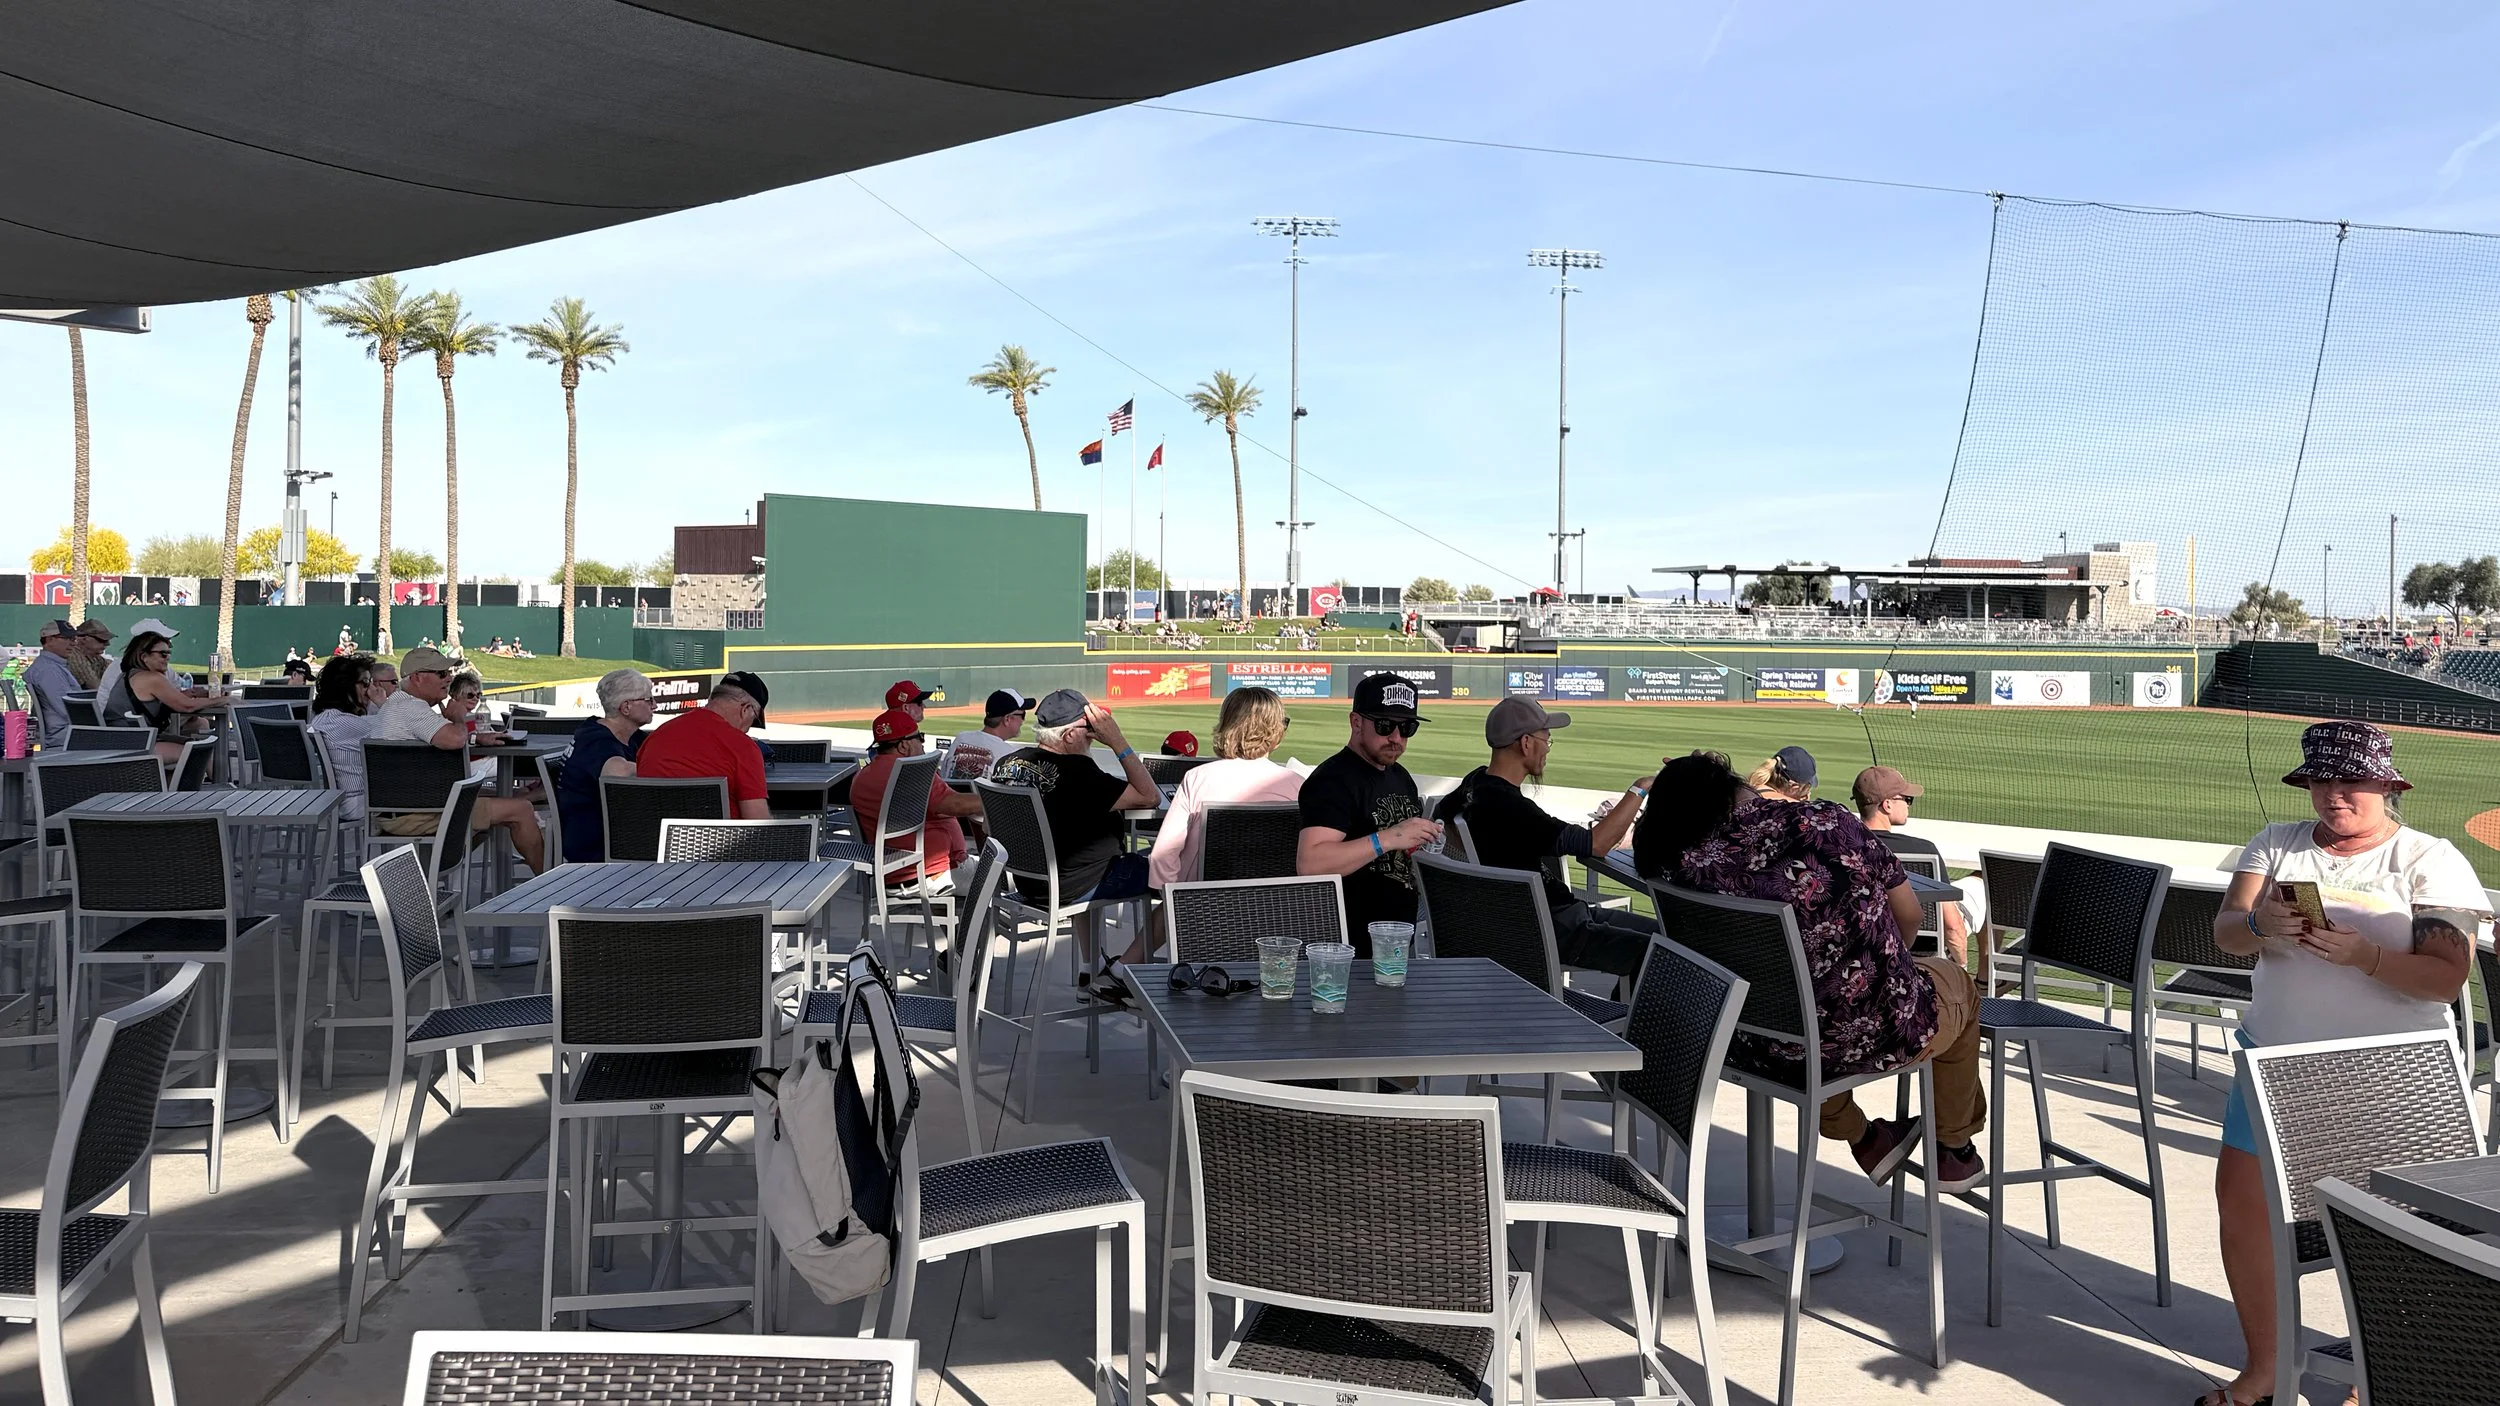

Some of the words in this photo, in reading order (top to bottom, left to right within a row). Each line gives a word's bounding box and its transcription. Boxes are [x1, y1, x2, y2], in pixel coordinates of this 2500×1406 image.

[1397, 670, 1436, 680] HOUSING
[1642, 671, 1681, 680] FirstStreet
[1761, 671, 1783, 681] Spring
[1784, 672, 1818, 681] Training's
[1897, 673, 1920, 684] Kids
[1920, 674, 1942, 685] Golf
[1943, 674, 1967, 684] Free
[1452, 687, 1470, 696] 380
[929, 692, 945, 701] 410
